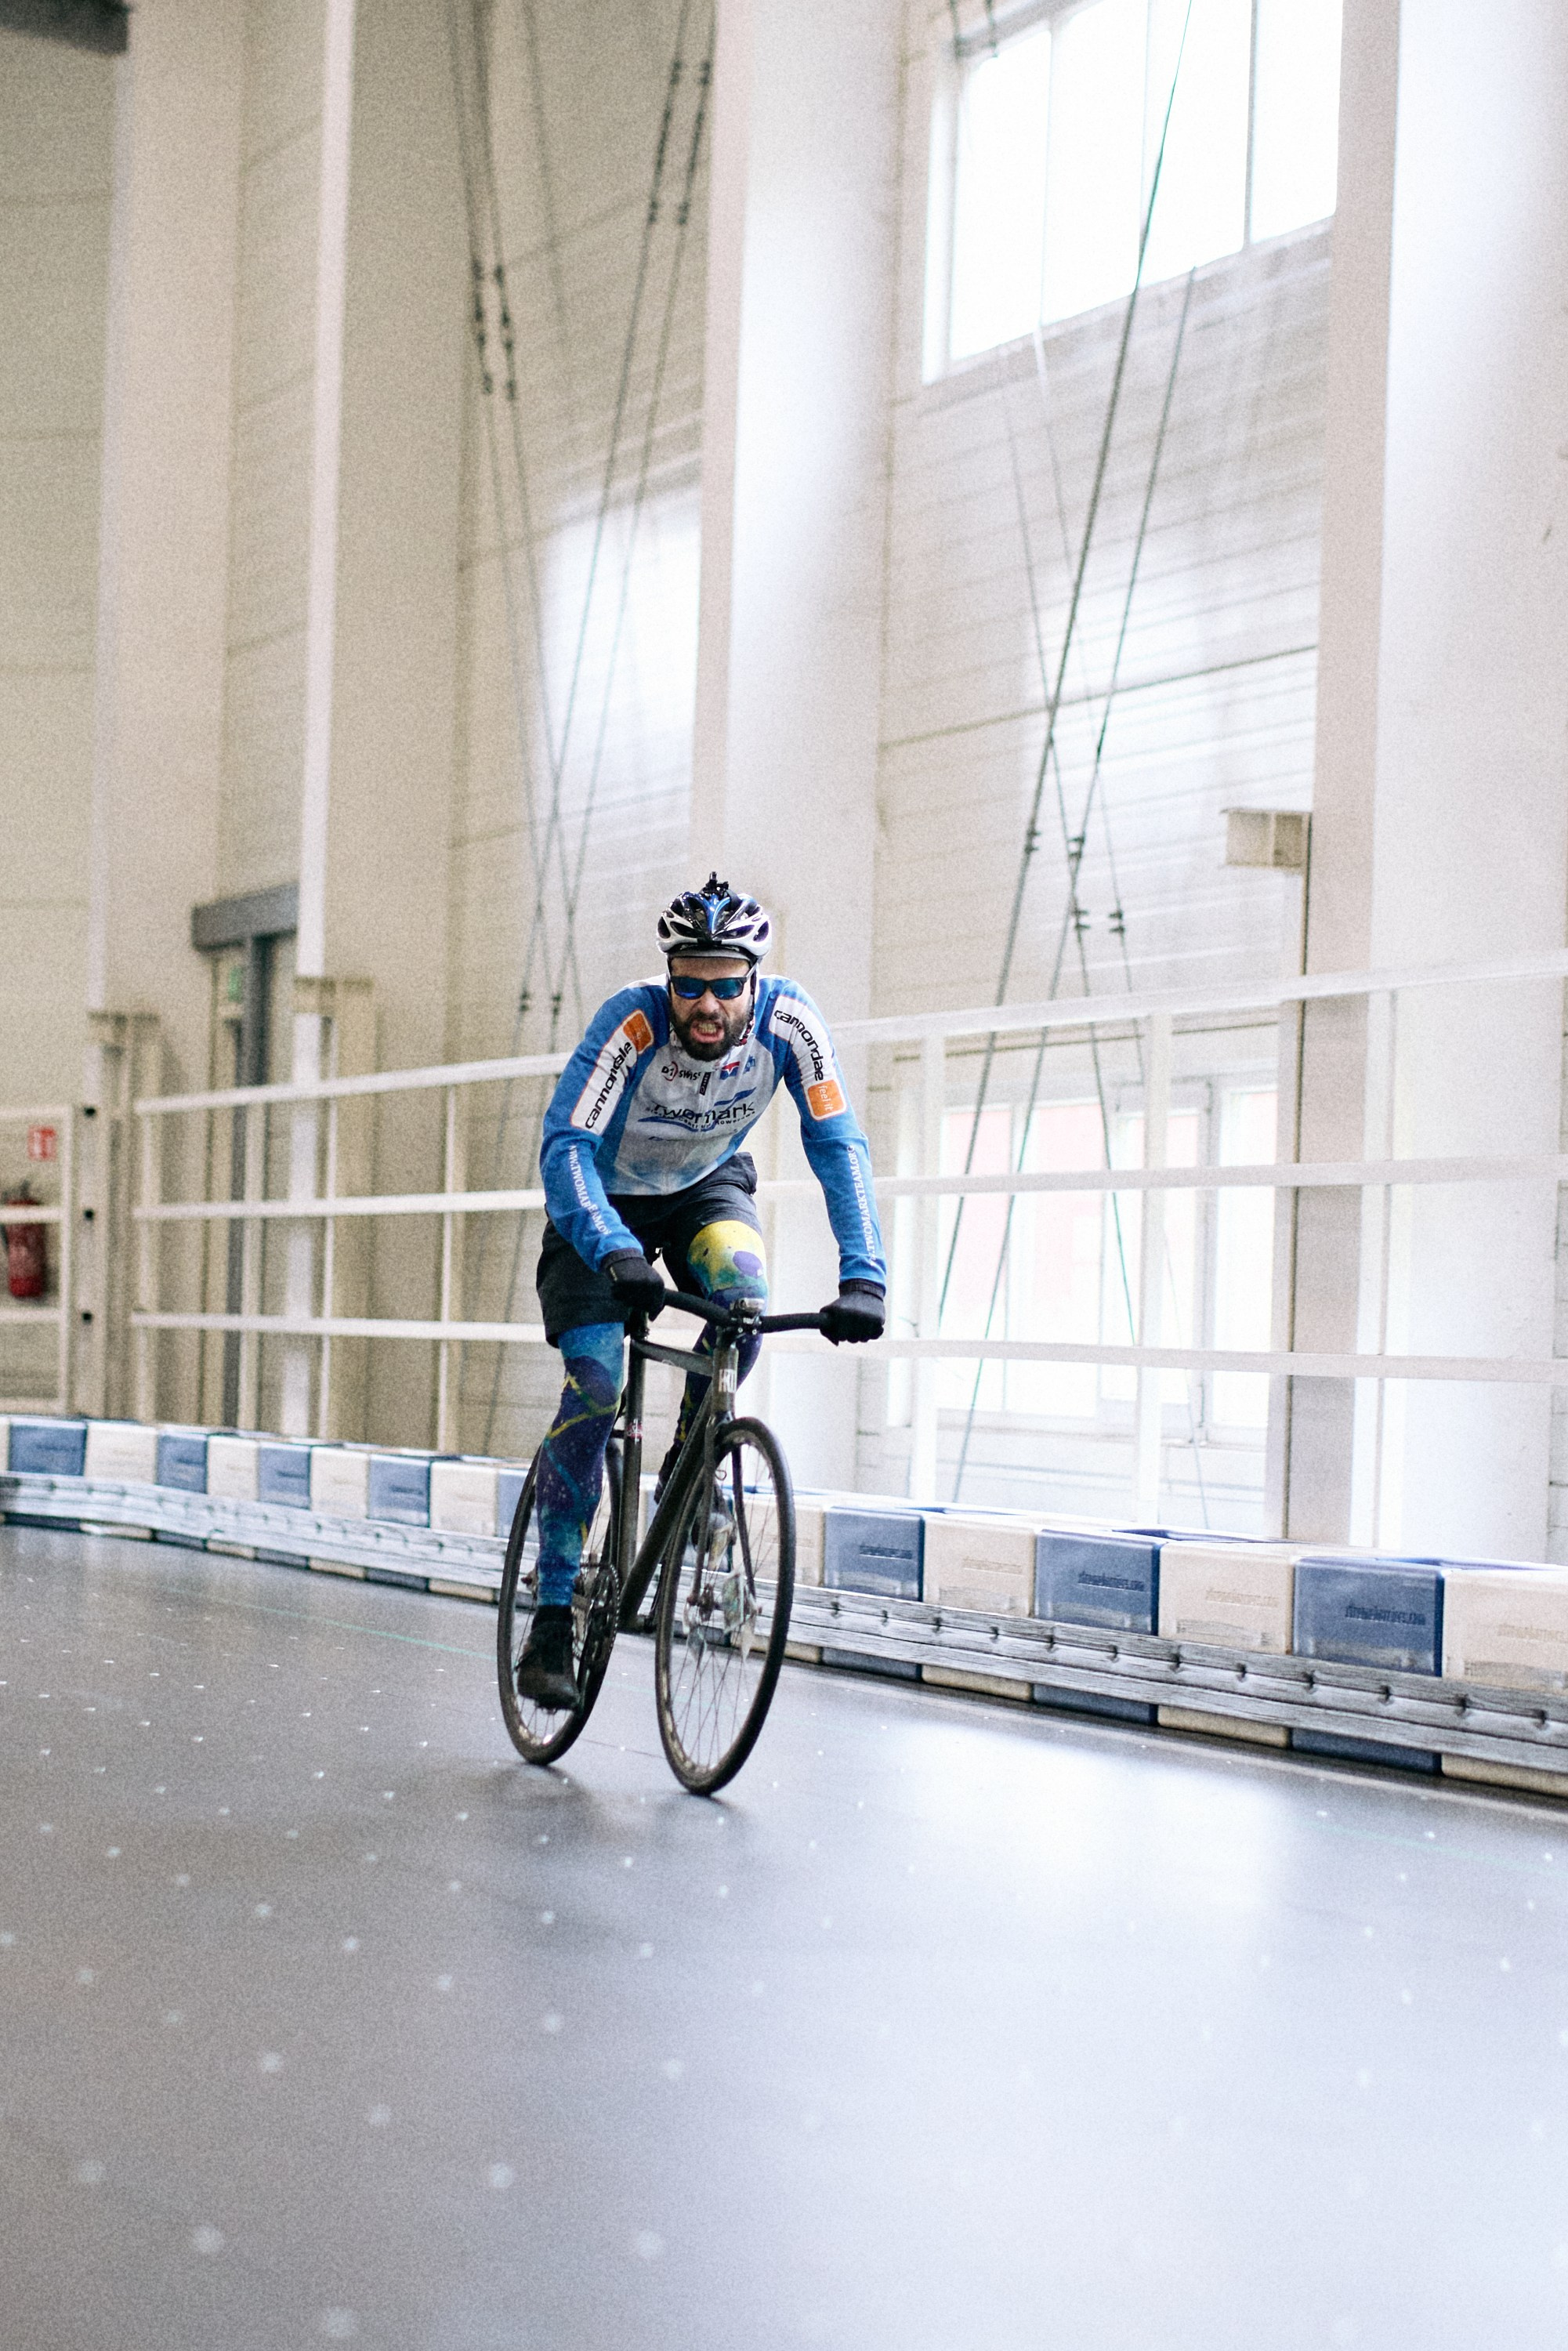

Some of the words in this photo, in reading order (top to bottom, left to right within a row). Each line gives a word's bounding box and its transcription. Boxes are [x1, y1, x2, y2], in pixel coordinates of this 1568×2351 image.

[774, 1010, 824, 1081] cannondae
[818, 1085, 831, 1103] feel
[824, 1101, 834, 1111] it
